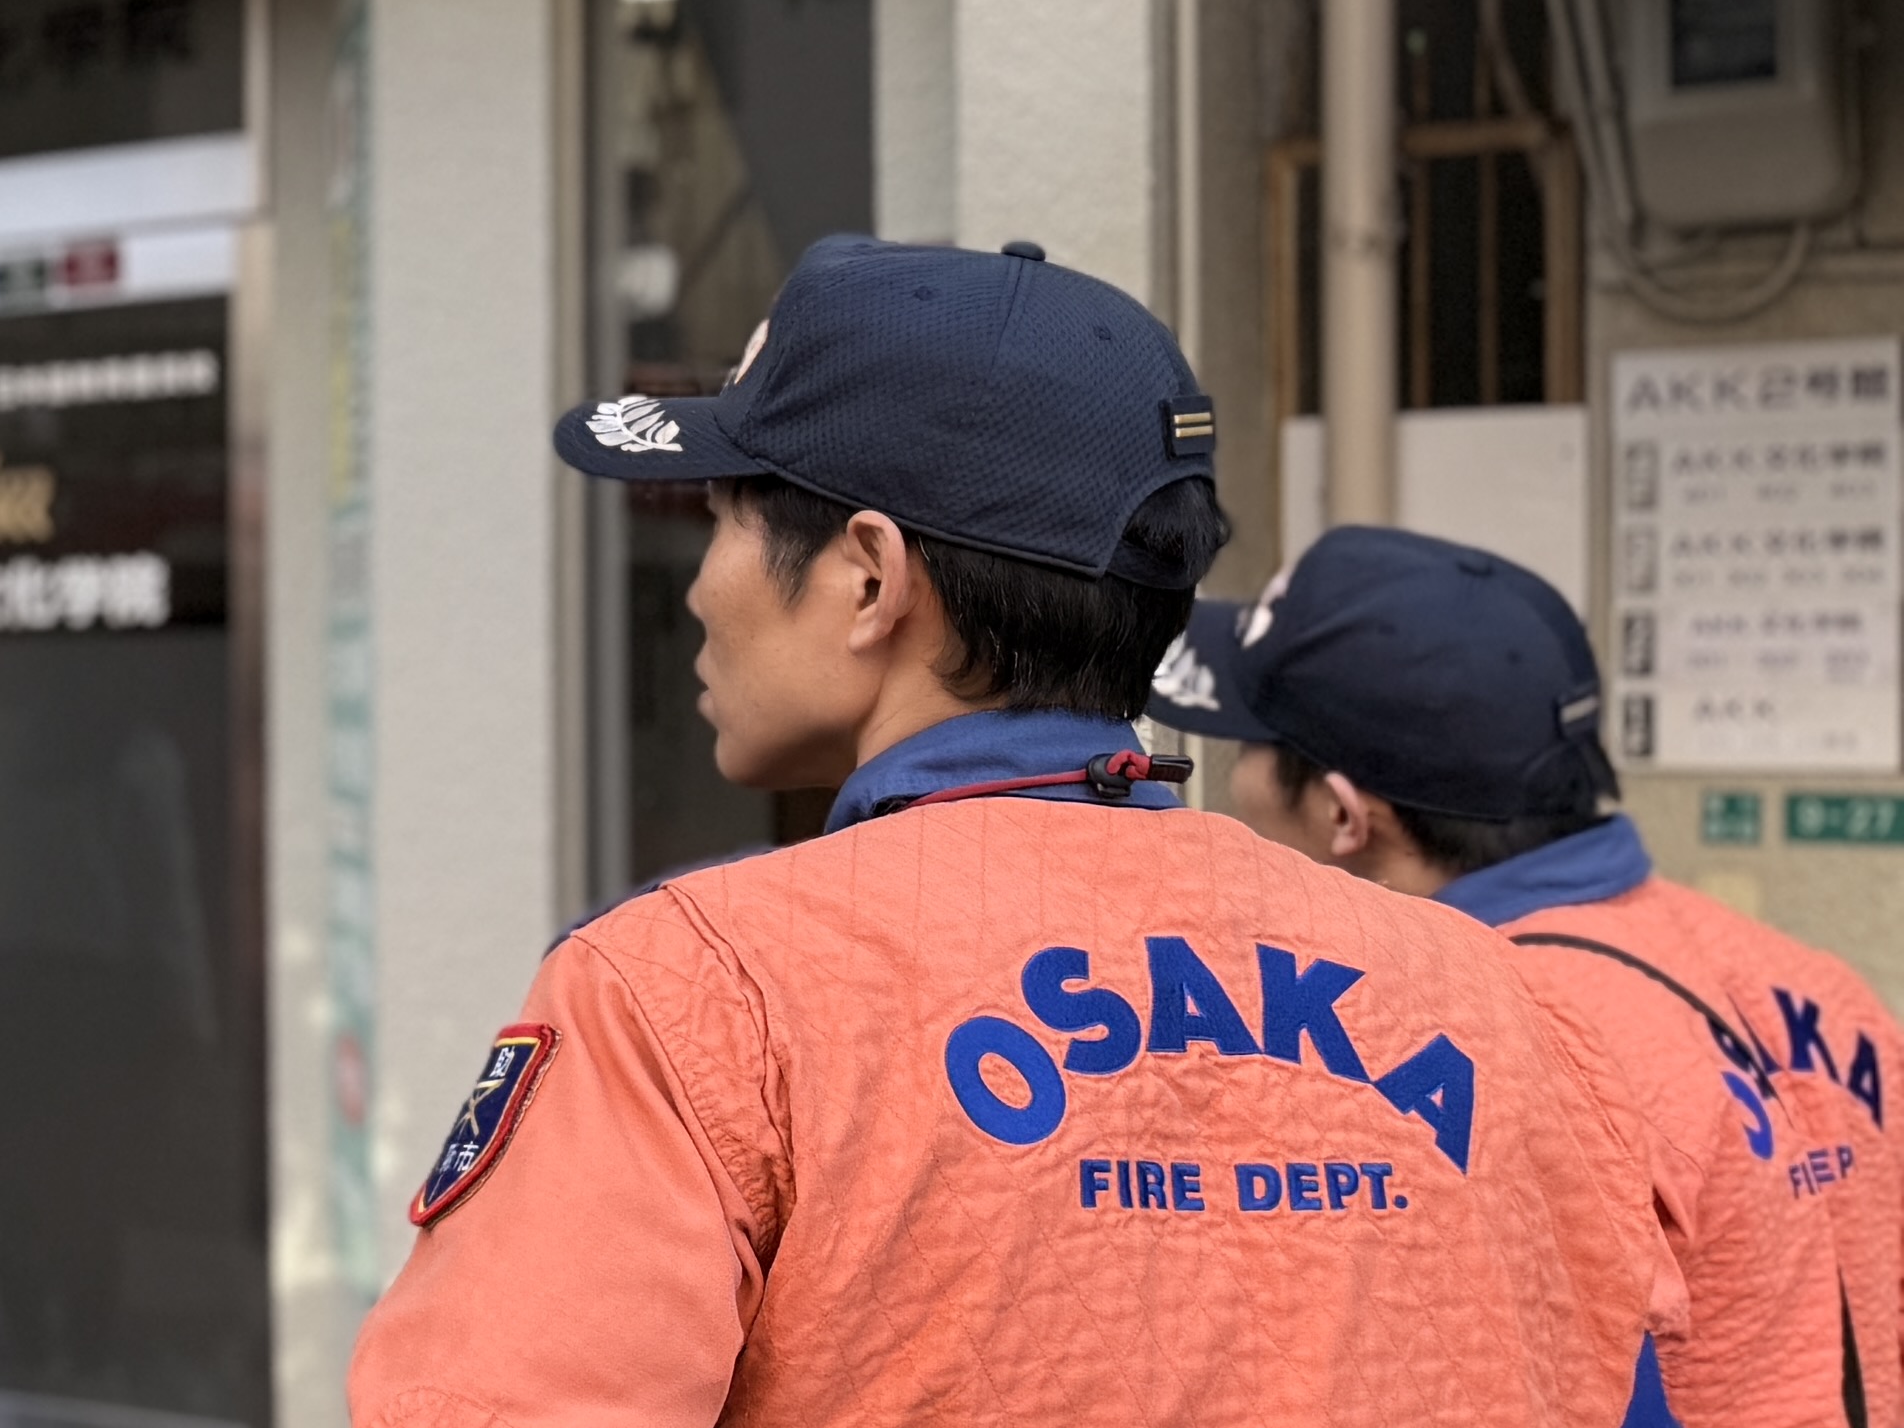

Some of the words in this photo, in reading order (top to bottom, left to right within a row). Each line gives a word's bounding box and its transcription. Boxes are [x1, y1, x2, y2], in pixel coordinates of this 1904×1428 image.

[944, 935, 1475, 1173] OSAKA
[1079, 1158, 1206, 1212] FIRE
[1237, 1161, 1409, 1212] DEPT.
